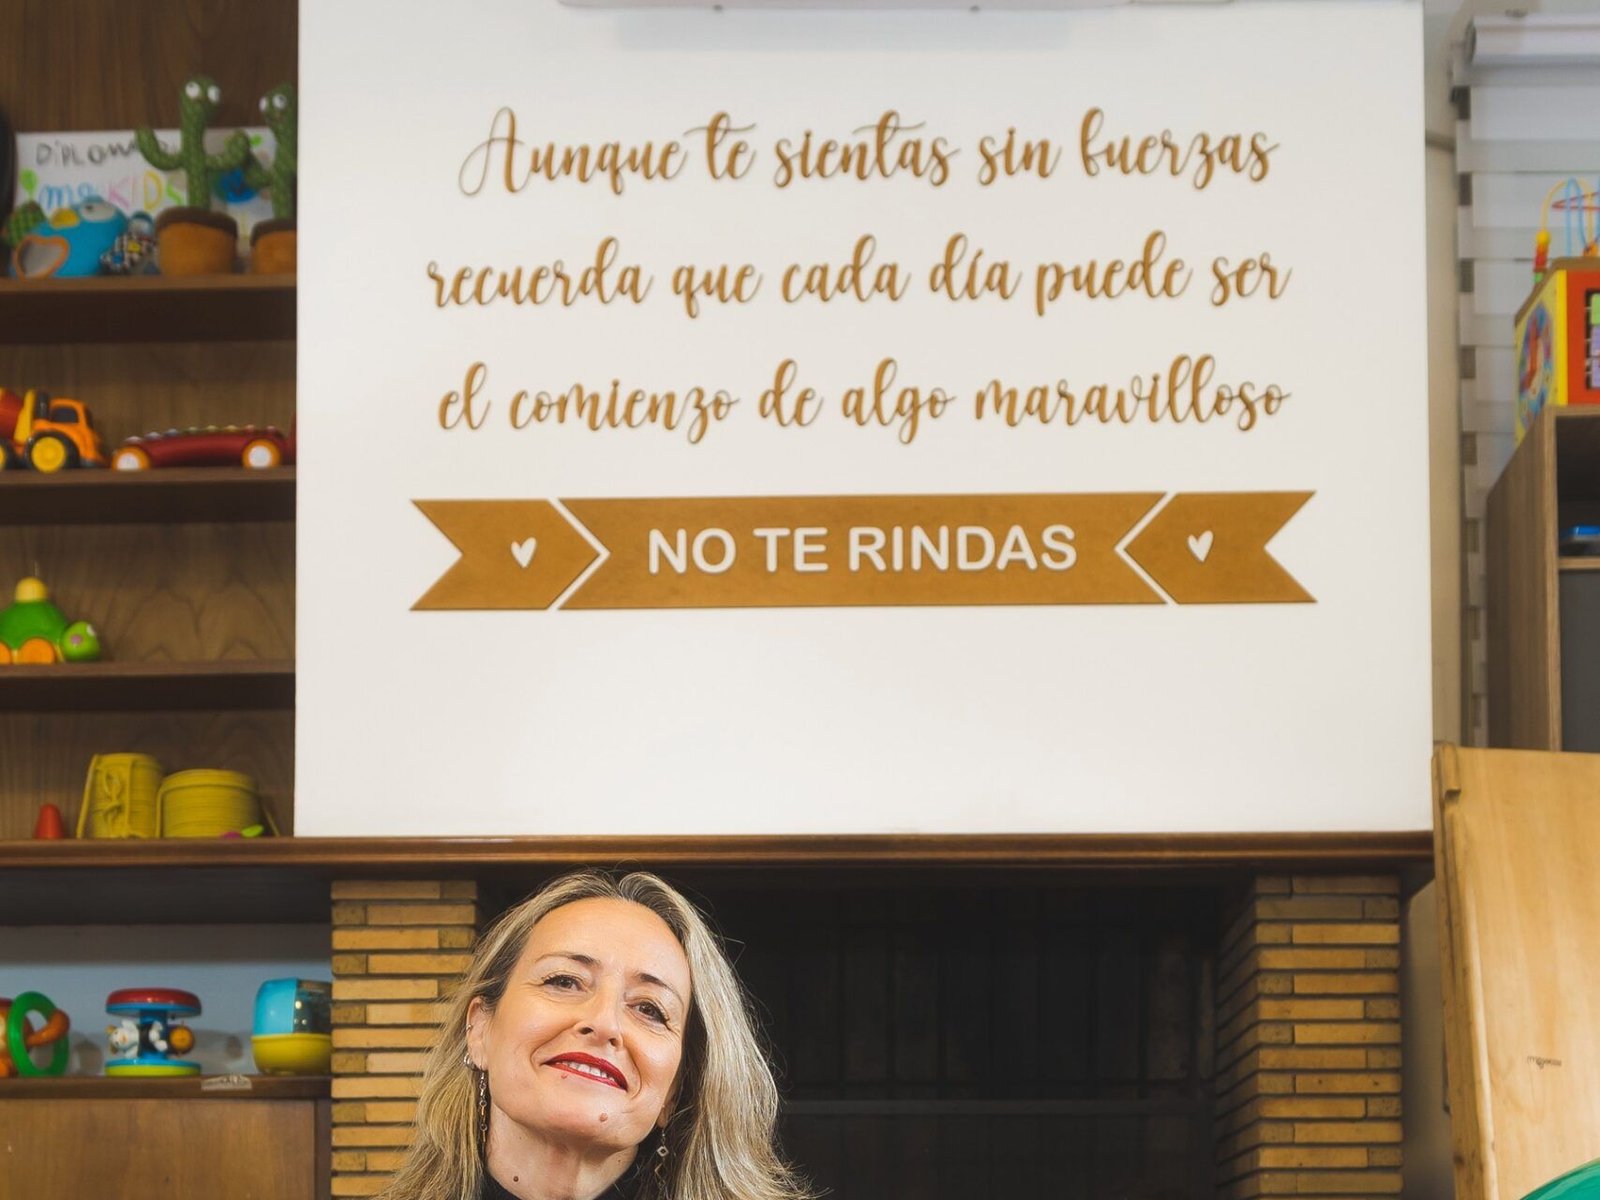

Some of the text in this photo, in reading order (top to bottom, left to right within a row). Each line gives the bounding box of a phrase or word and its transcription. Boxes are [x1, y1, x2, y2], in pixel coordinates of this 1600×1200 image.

[458, 106, 689, 196] Aunque
[684, 110, 757, 181] te
[773, 110, 961, 190] sientas
[977, 127, 1062, 187] sin
[427, 230, 1292, 319] recuerda que cada día puede ser
[437, 353, 1292, 446] el comienzo de algo maravilloso
[648, 525, 1077, 575] NO TE RINDAS
